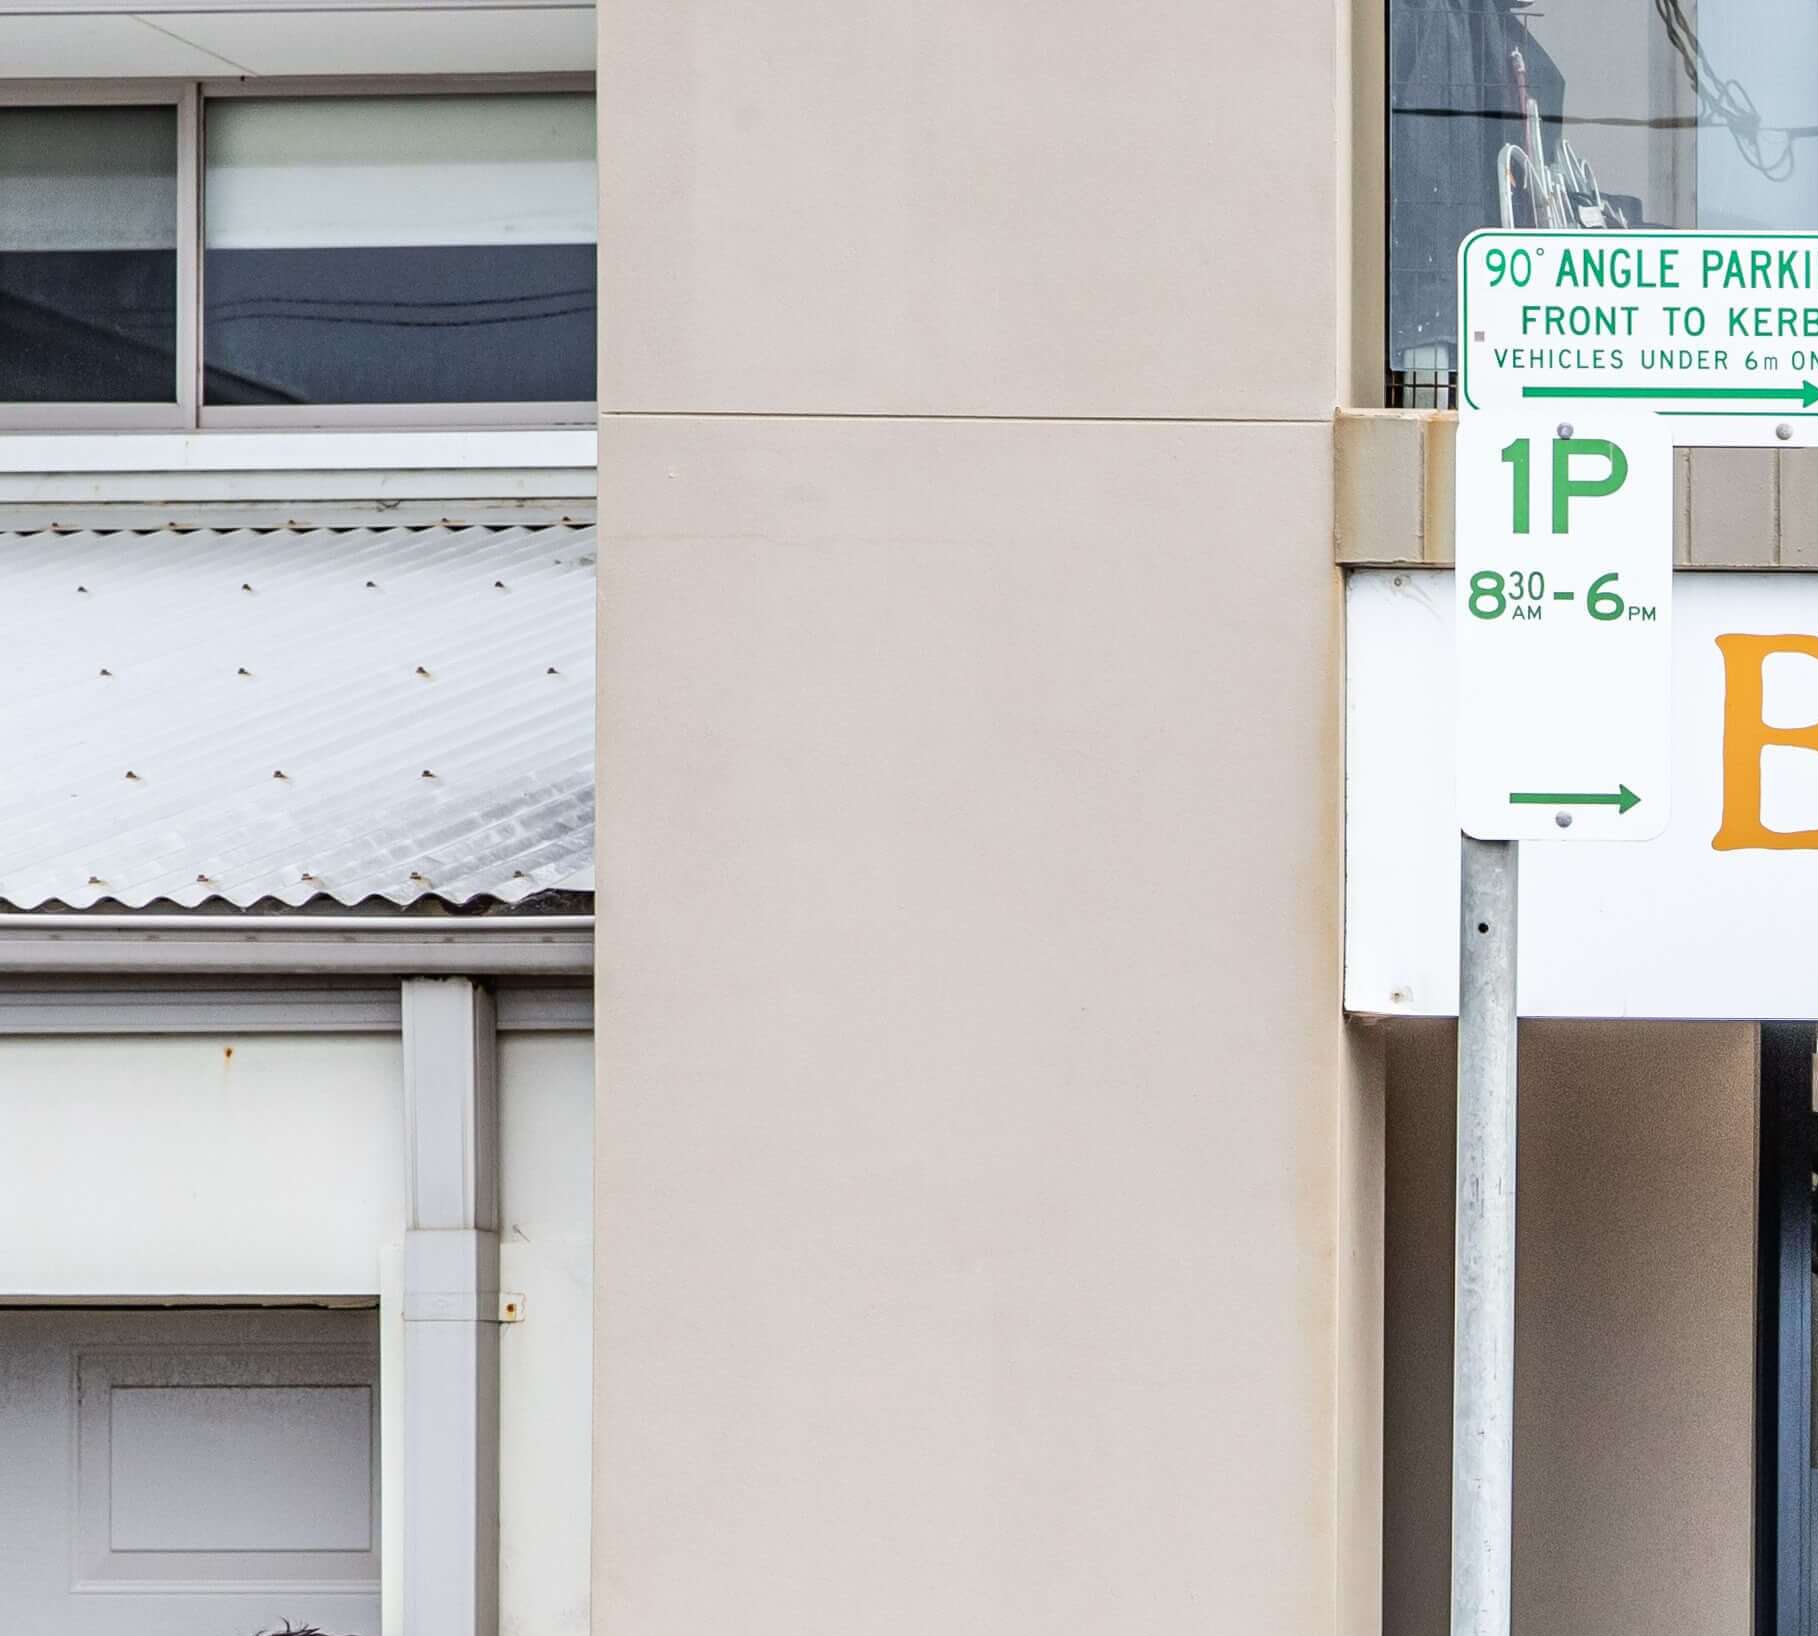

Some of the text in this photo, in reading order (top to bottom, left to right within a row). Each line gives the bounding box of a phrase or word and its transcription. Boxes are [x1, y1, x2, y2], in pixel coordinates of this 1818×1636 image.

[1555, 248, 1680, 289] ANGLE
[1521, 305, 1638, 336] FRONT
[1663, 306, 1706, 337] TO
[1494, 349, 1623, 369] VEHICLES
[1641, 350, 1728, 369] UNDER
[1744, 351, 1779, 370] 6m
[1502, 438, 1628, 534] 1P
